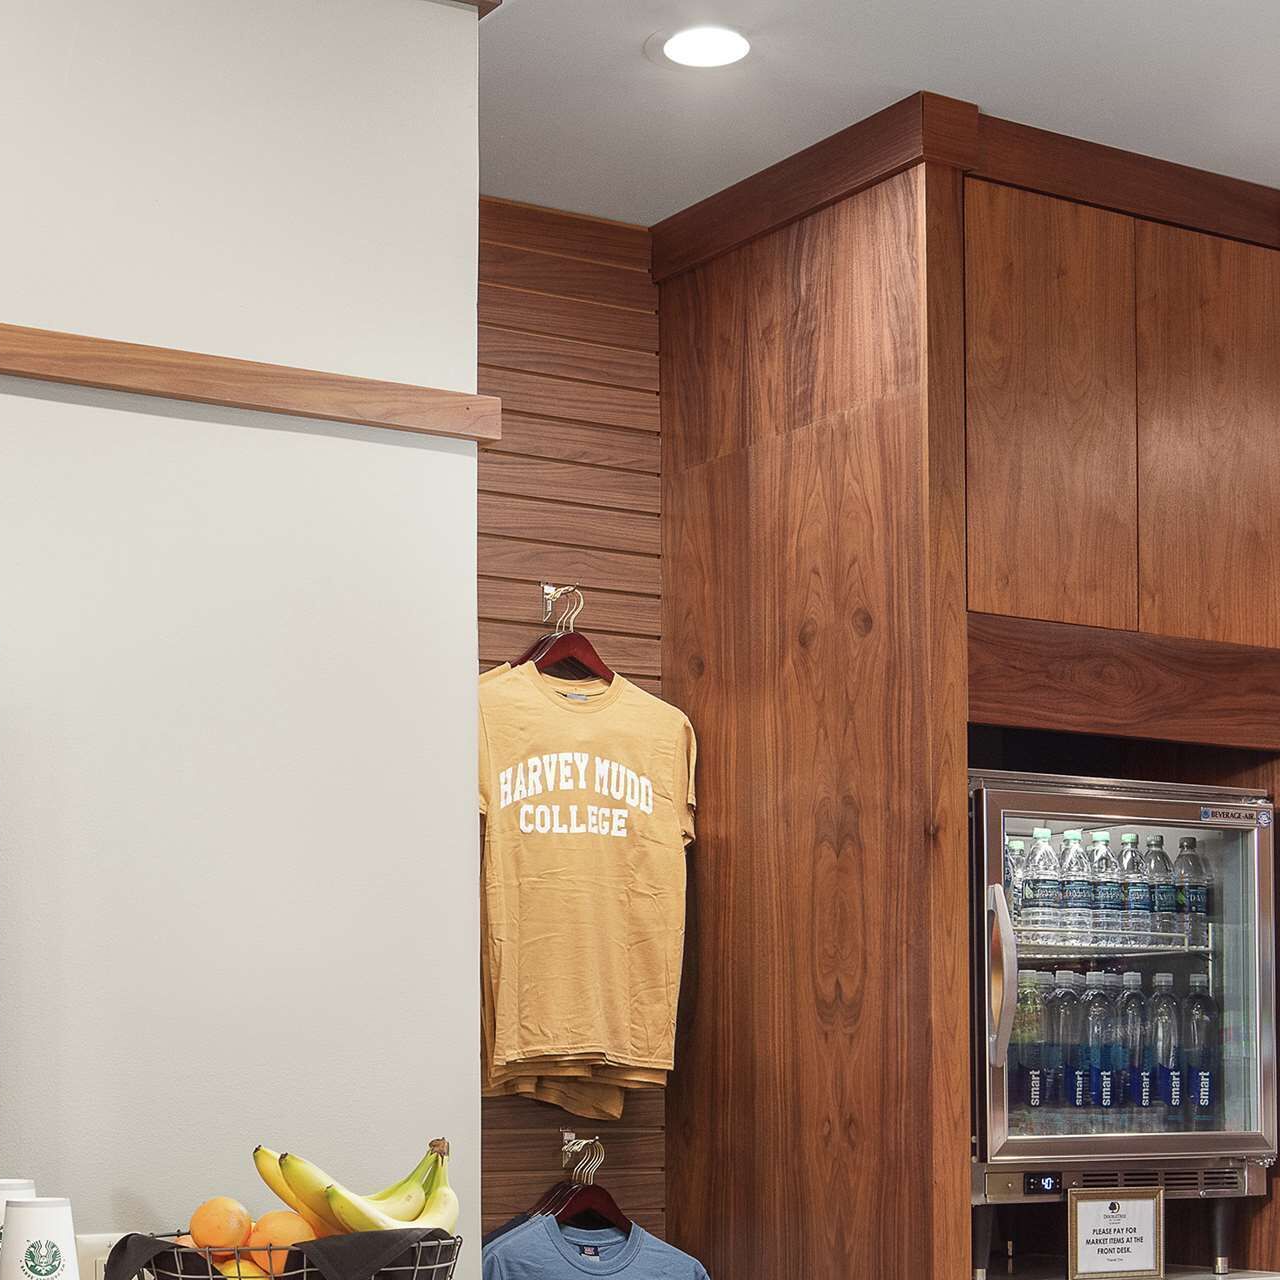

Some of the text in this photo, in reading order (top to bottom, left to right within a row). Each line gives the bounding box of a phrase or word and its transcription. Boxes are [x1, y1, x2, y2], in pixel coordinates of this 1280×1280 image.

[499, 752, 654, 816] HARVEY MUDD
[520, 804, 628, 837] COLLEGE
[1030, 1069, 1040, 1106] smart
[1075, 1070, 1084, 1106] smart
[1100, 1070, 1112, 1106] smart
[1140, 1071, 1150, 1106] smart
[1171, 1070, 1181, 1106] smart
[1198, 1071, 1210, 1106] smart
[1041, 1177, 1053, 1189] 40
